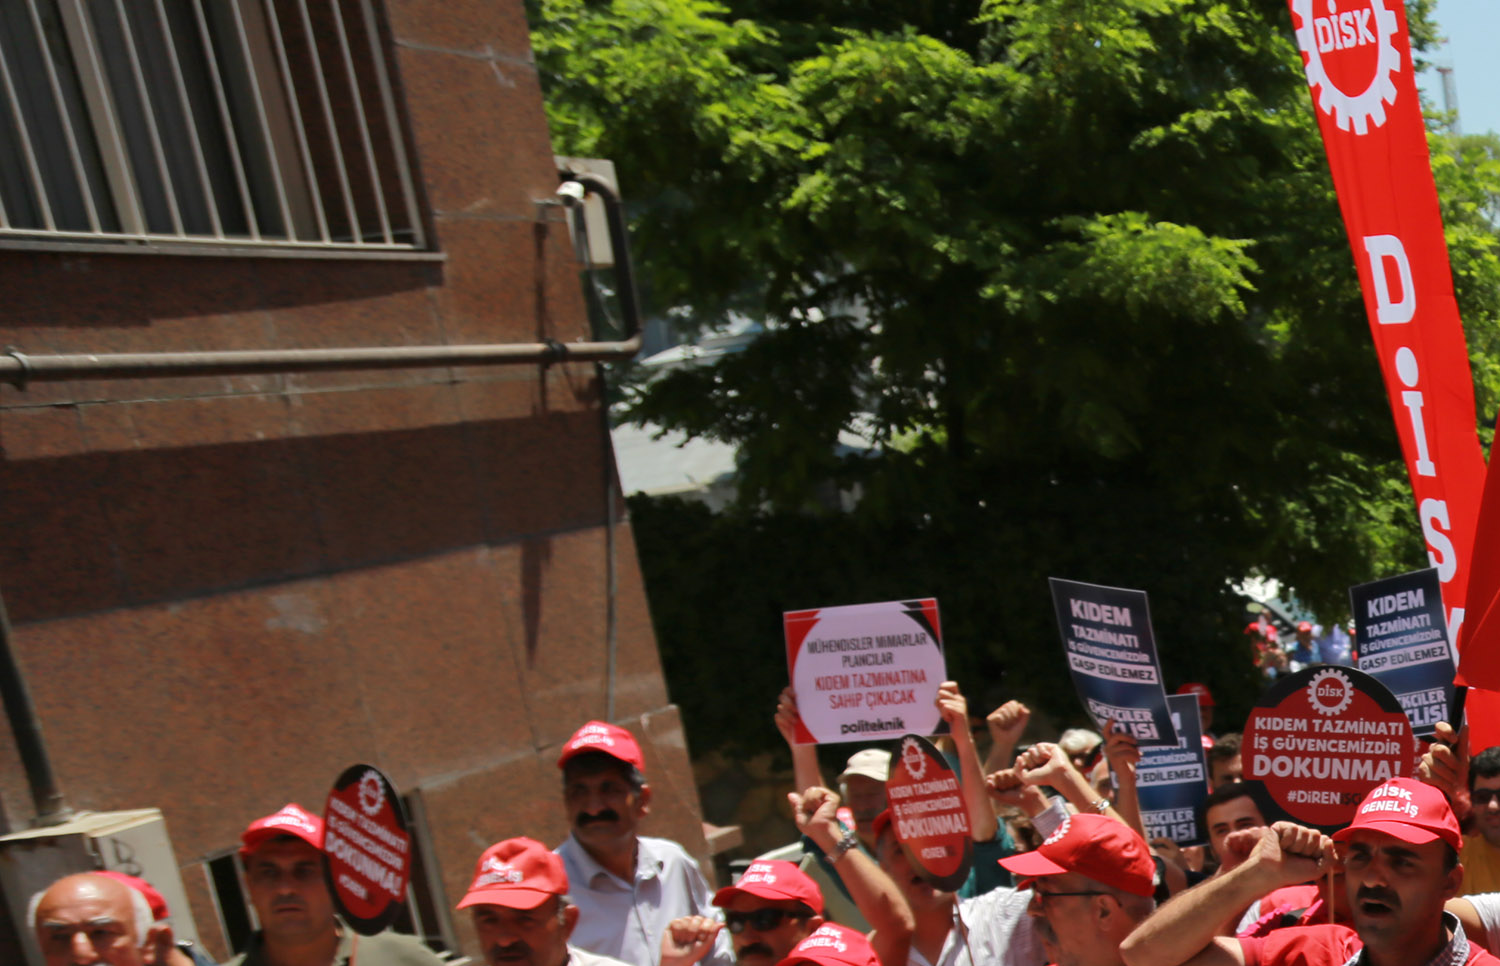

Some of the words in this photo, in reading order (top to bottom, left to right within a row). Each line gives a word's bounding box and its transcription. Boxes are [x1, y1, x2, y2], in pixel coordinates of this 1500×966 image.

[1314, 0, 1377, 53] DİSK
[1070, 598, 1132, 627] KIDEM
[1368, 588, 1425, 618] KIDEM
[1072, 624, 1139, 648] TAZMİNATI
[1366, 613, 1431, 638] TAZMİNATI
[807, 637, 873, 654] MÜHENDİSLER
[876, 632, 927, 648] MİMARLAR
[1077, 642, 1150, 663] GÜVENCEMİZDİR
[1360, 643, 1368, 655] İŞ
[1369, 629, 1442, 651] GÜVENCEMİZDİR
[842, 652, 893, 668] PLANCILAR
[1072, 657, 1096, 671] GASP
[1100, 664, 1154, 680] EDİLEMEZ
[1361, 657, 1387, 671] GASP
[1390, 646, 1446, 665] EDİLEMEZ
[815, 675, 850, 691] KIDEM
[852, 669, 927, 688] TAZMİNATINA
[1317, 684, 1343, 697] DİSK
[829, 692, 862, 710] SAHİP
[866, 689, 917, 710] ÇIKACAK
[841, 717, 905, 735] politeknik
[1255, 717, 1308, 732] KIDEM
[1312, 718, 1404, 736] TAZMİNATI
[1254, 733, 1268, 753] İŞ
[1272, 735, 1401, 755] GÜVENCEMİZDİR
[1143, 768, 1200, 782] EDİLEMEZ
[1253, 754, 1402, 781] DOKUNMA!
[1372, 784, 1413, 800] DİSK
[1361, 800, 1419, 818] GENEL-İŞ
[898, 813, 968, 840] DOKUNMA!
[325, 831, 402, 897] DOKUNMA!
